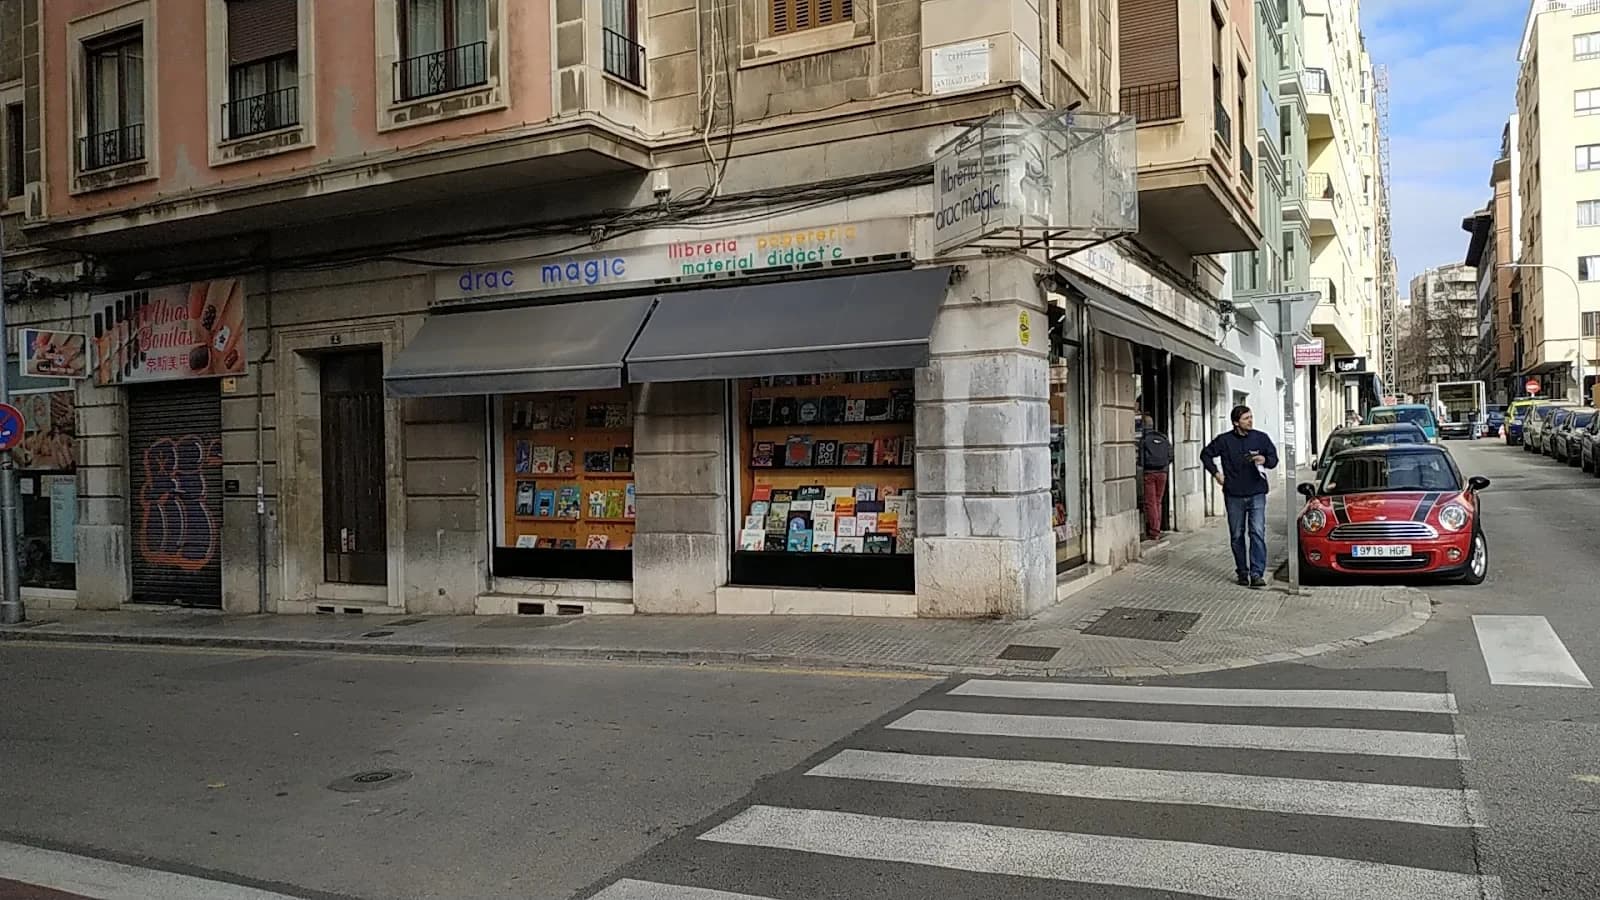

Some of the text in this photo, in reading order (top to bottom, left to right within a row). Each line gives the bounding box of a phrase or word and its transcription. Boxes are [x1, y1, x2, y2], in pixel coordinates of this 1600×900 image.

[668, 239, 738, 259] llibreria
[459, 256, 625, 291] drac màgic
[682, 252, 754, 275] material
[1389, 546, 1408, 555] HGF
